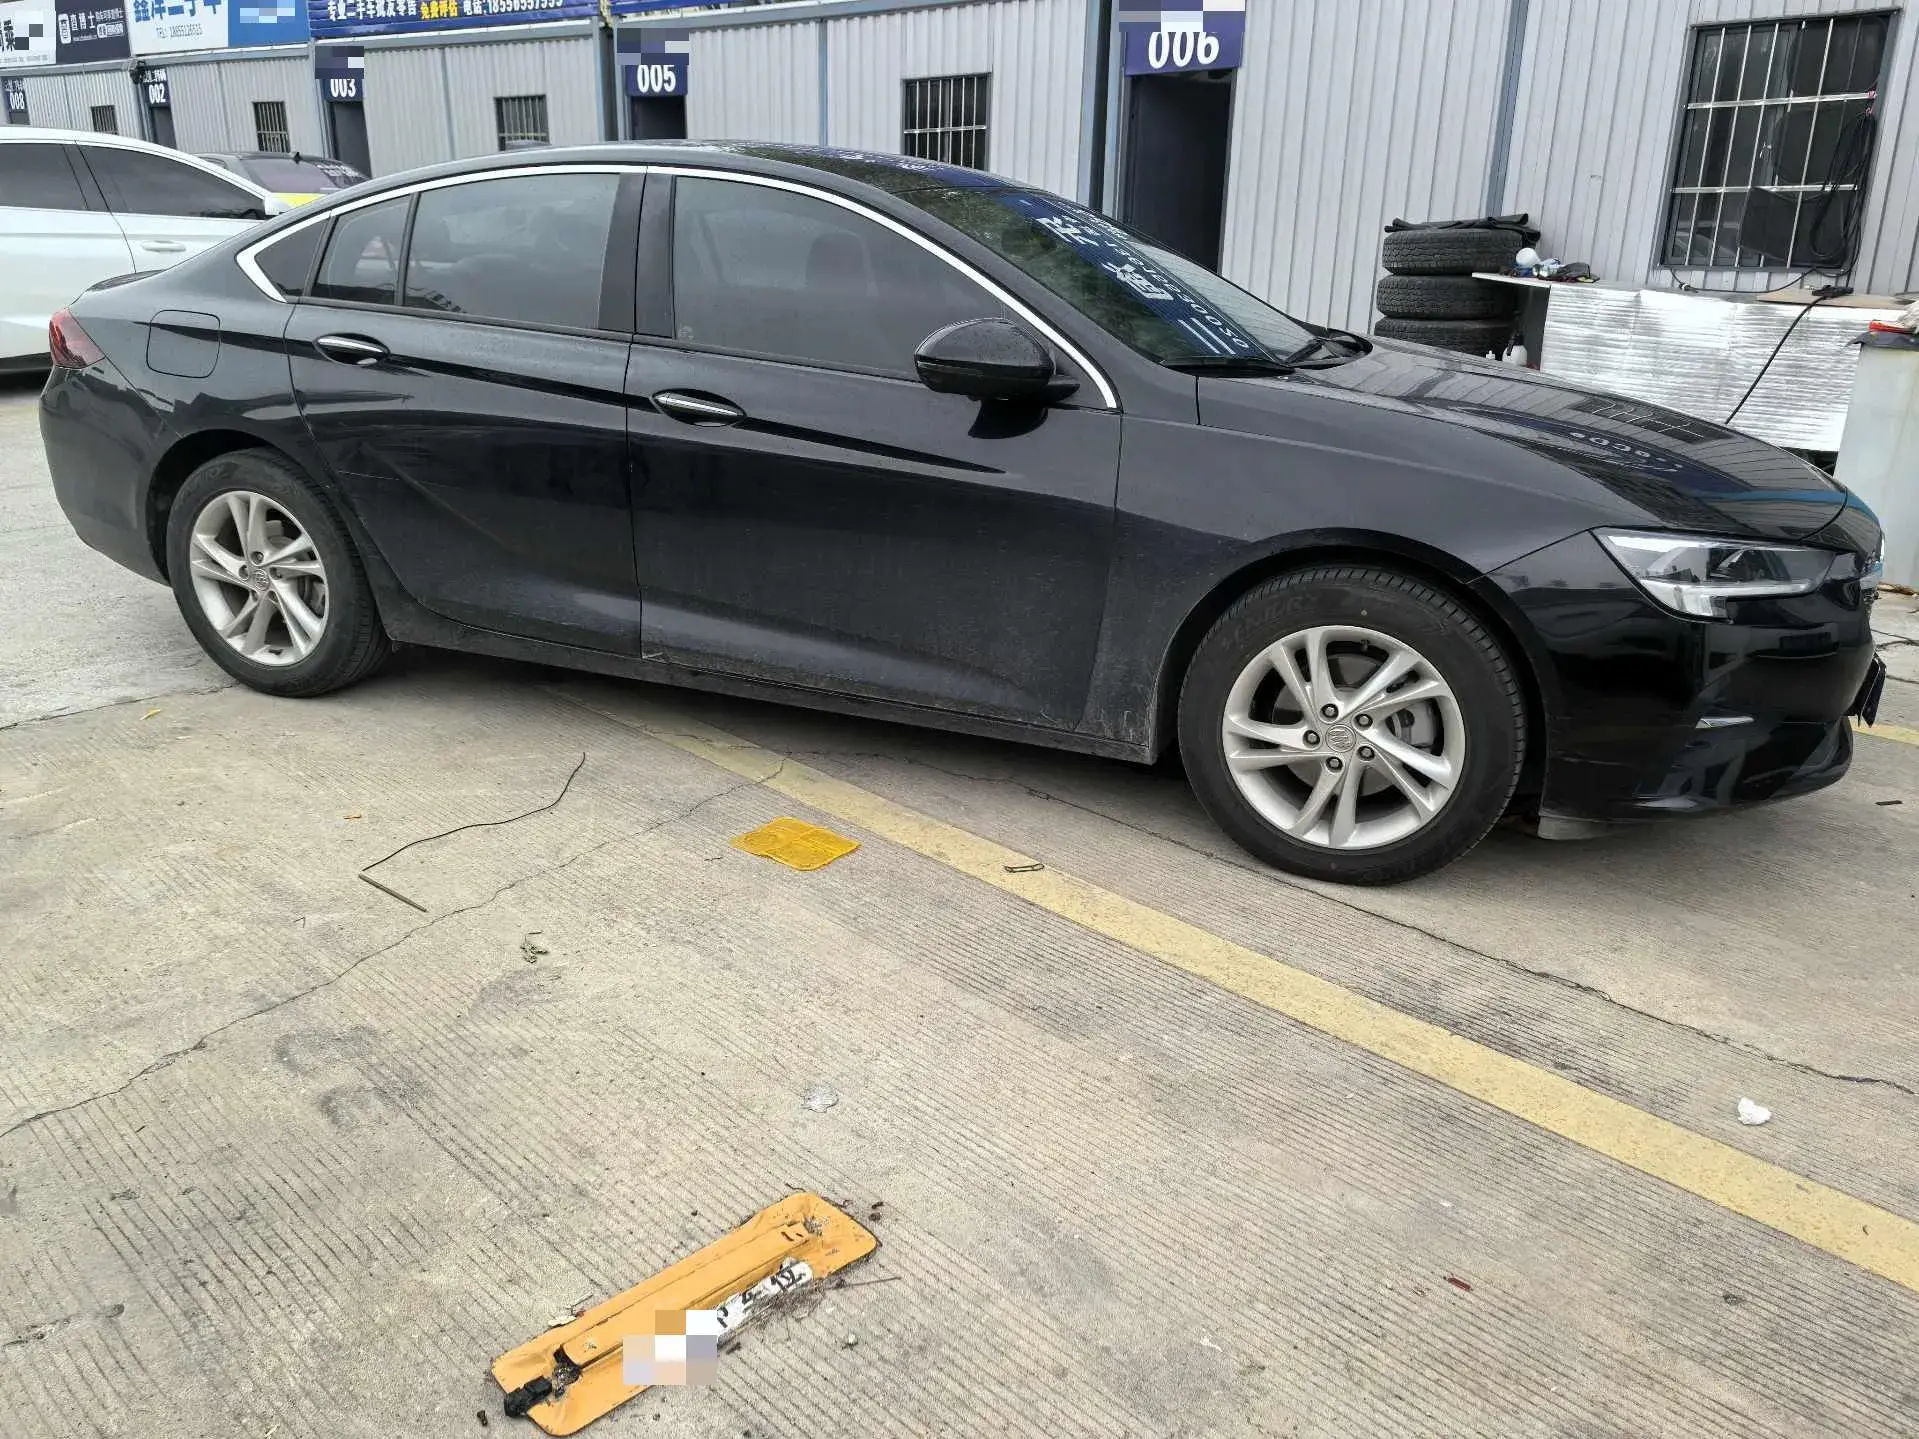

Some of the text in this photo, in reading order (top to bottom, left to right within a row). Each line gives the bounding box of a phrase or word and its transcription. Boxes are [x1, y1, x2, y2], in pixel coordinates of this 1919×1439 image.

[1148, 32, 1220, 69] 006
[330, 78, 356, 98] 003
[637, 64, 676, 93] 005
[148, 83, 166, 104] 002
